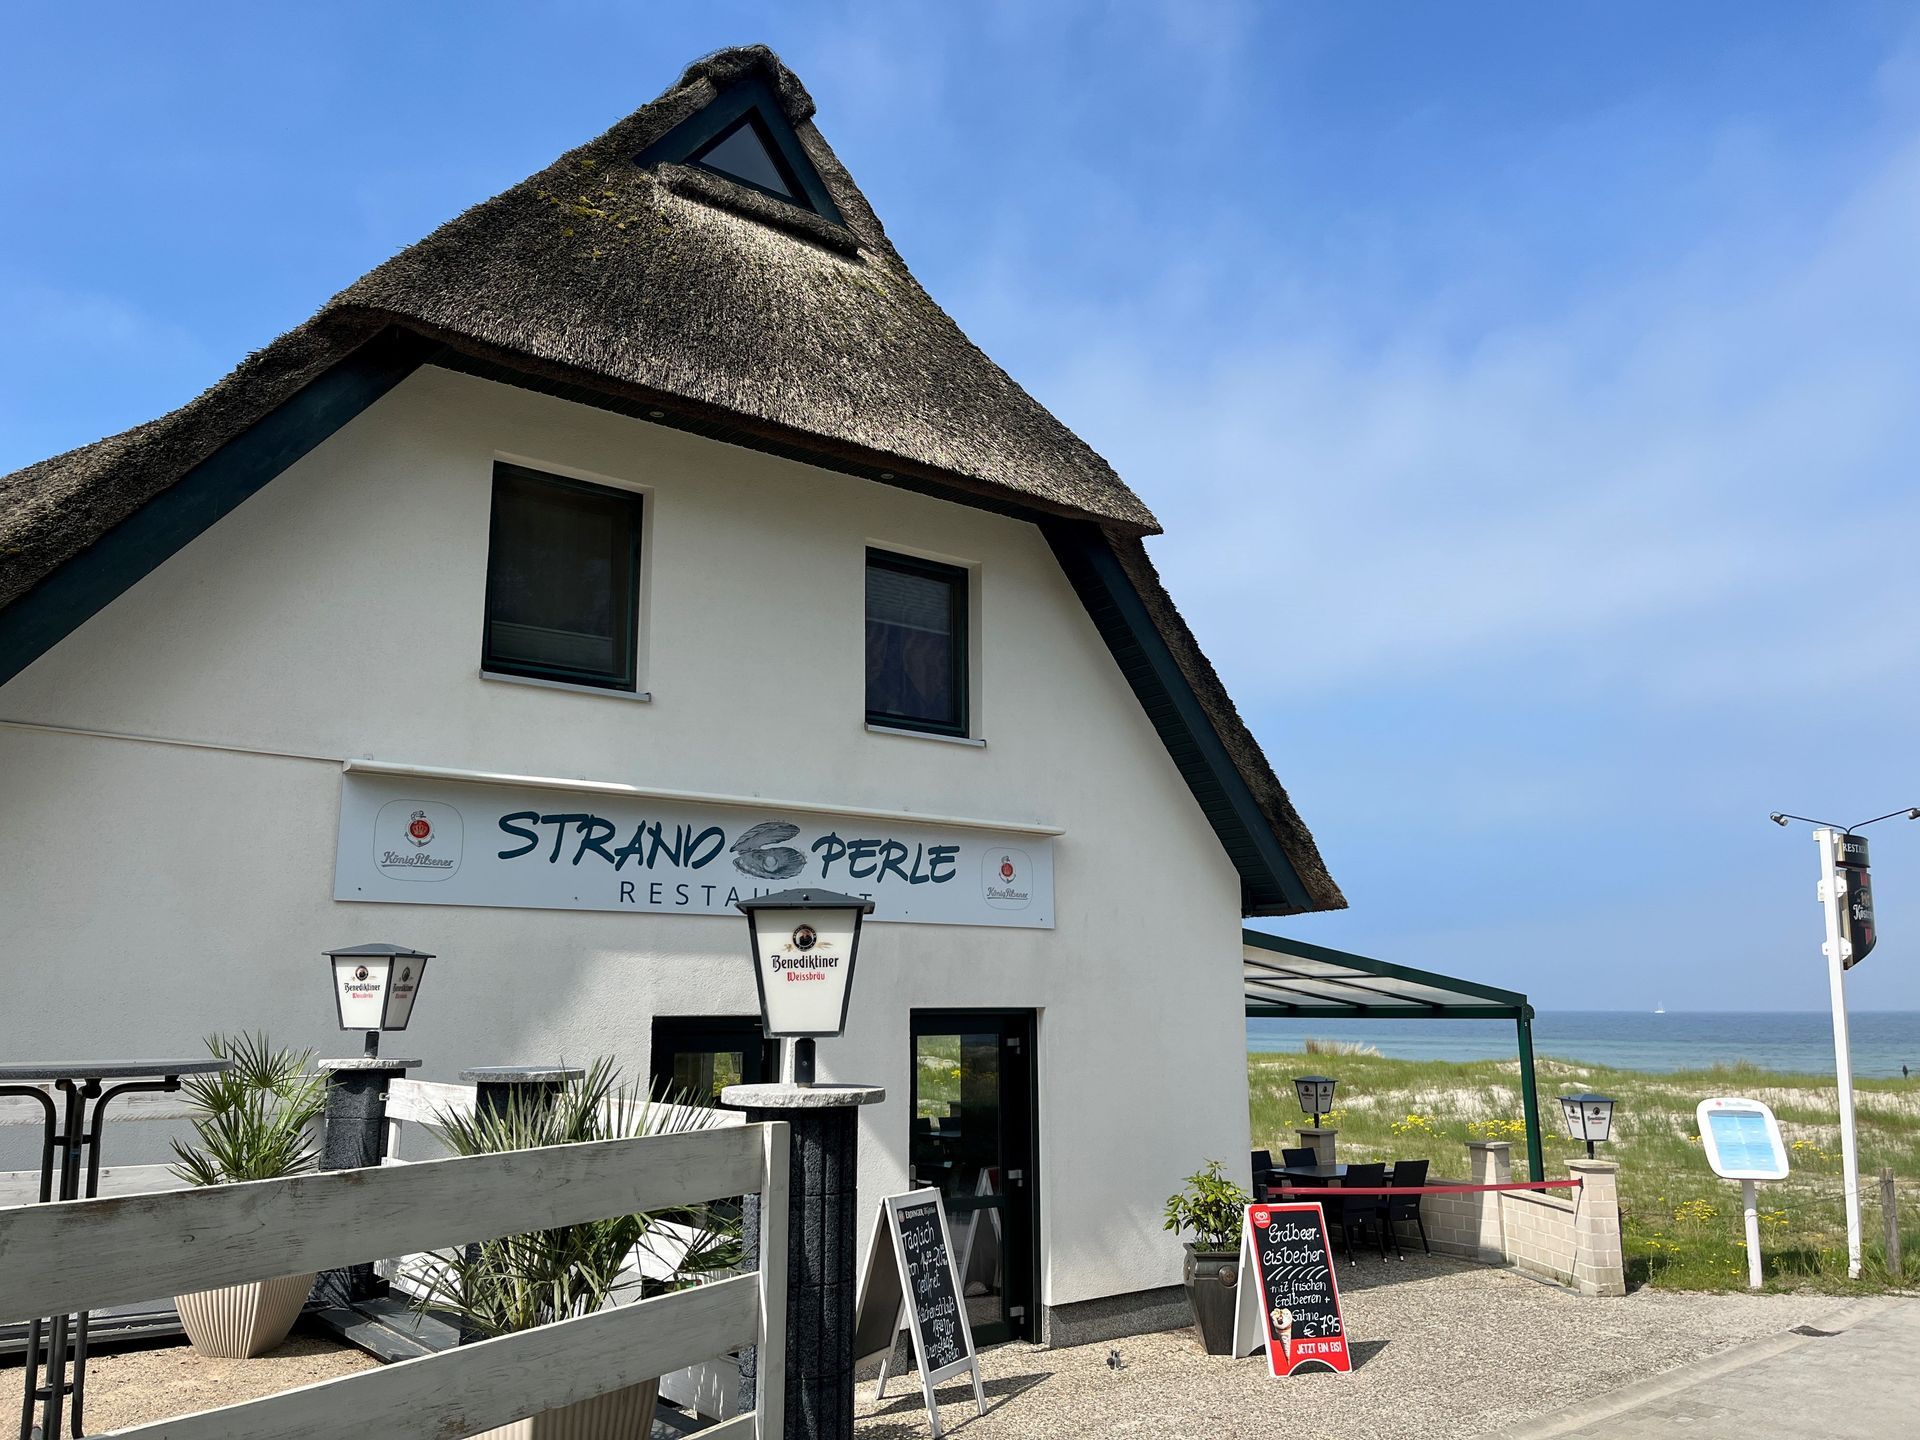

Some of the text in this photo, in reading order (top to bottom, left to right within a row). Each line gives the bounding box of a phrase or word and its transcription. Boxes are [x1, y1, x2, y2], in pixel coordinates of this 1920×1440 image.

[497, 811, 961, 884] STRAND PERLE
[771, 955, 839, 972] Benediktiner
[787, 971, 825, 982] Weissbräu
[1292, 1279, 1327, 1294] frischen
[1275, 1292, 1322, 1307] Erdbeeren
[1292, 1309, 1319, 1322] Sahne
[1297, 1342, 1316, 1354] JETZT
[1318, 1342, 1329, 1353] EIN
